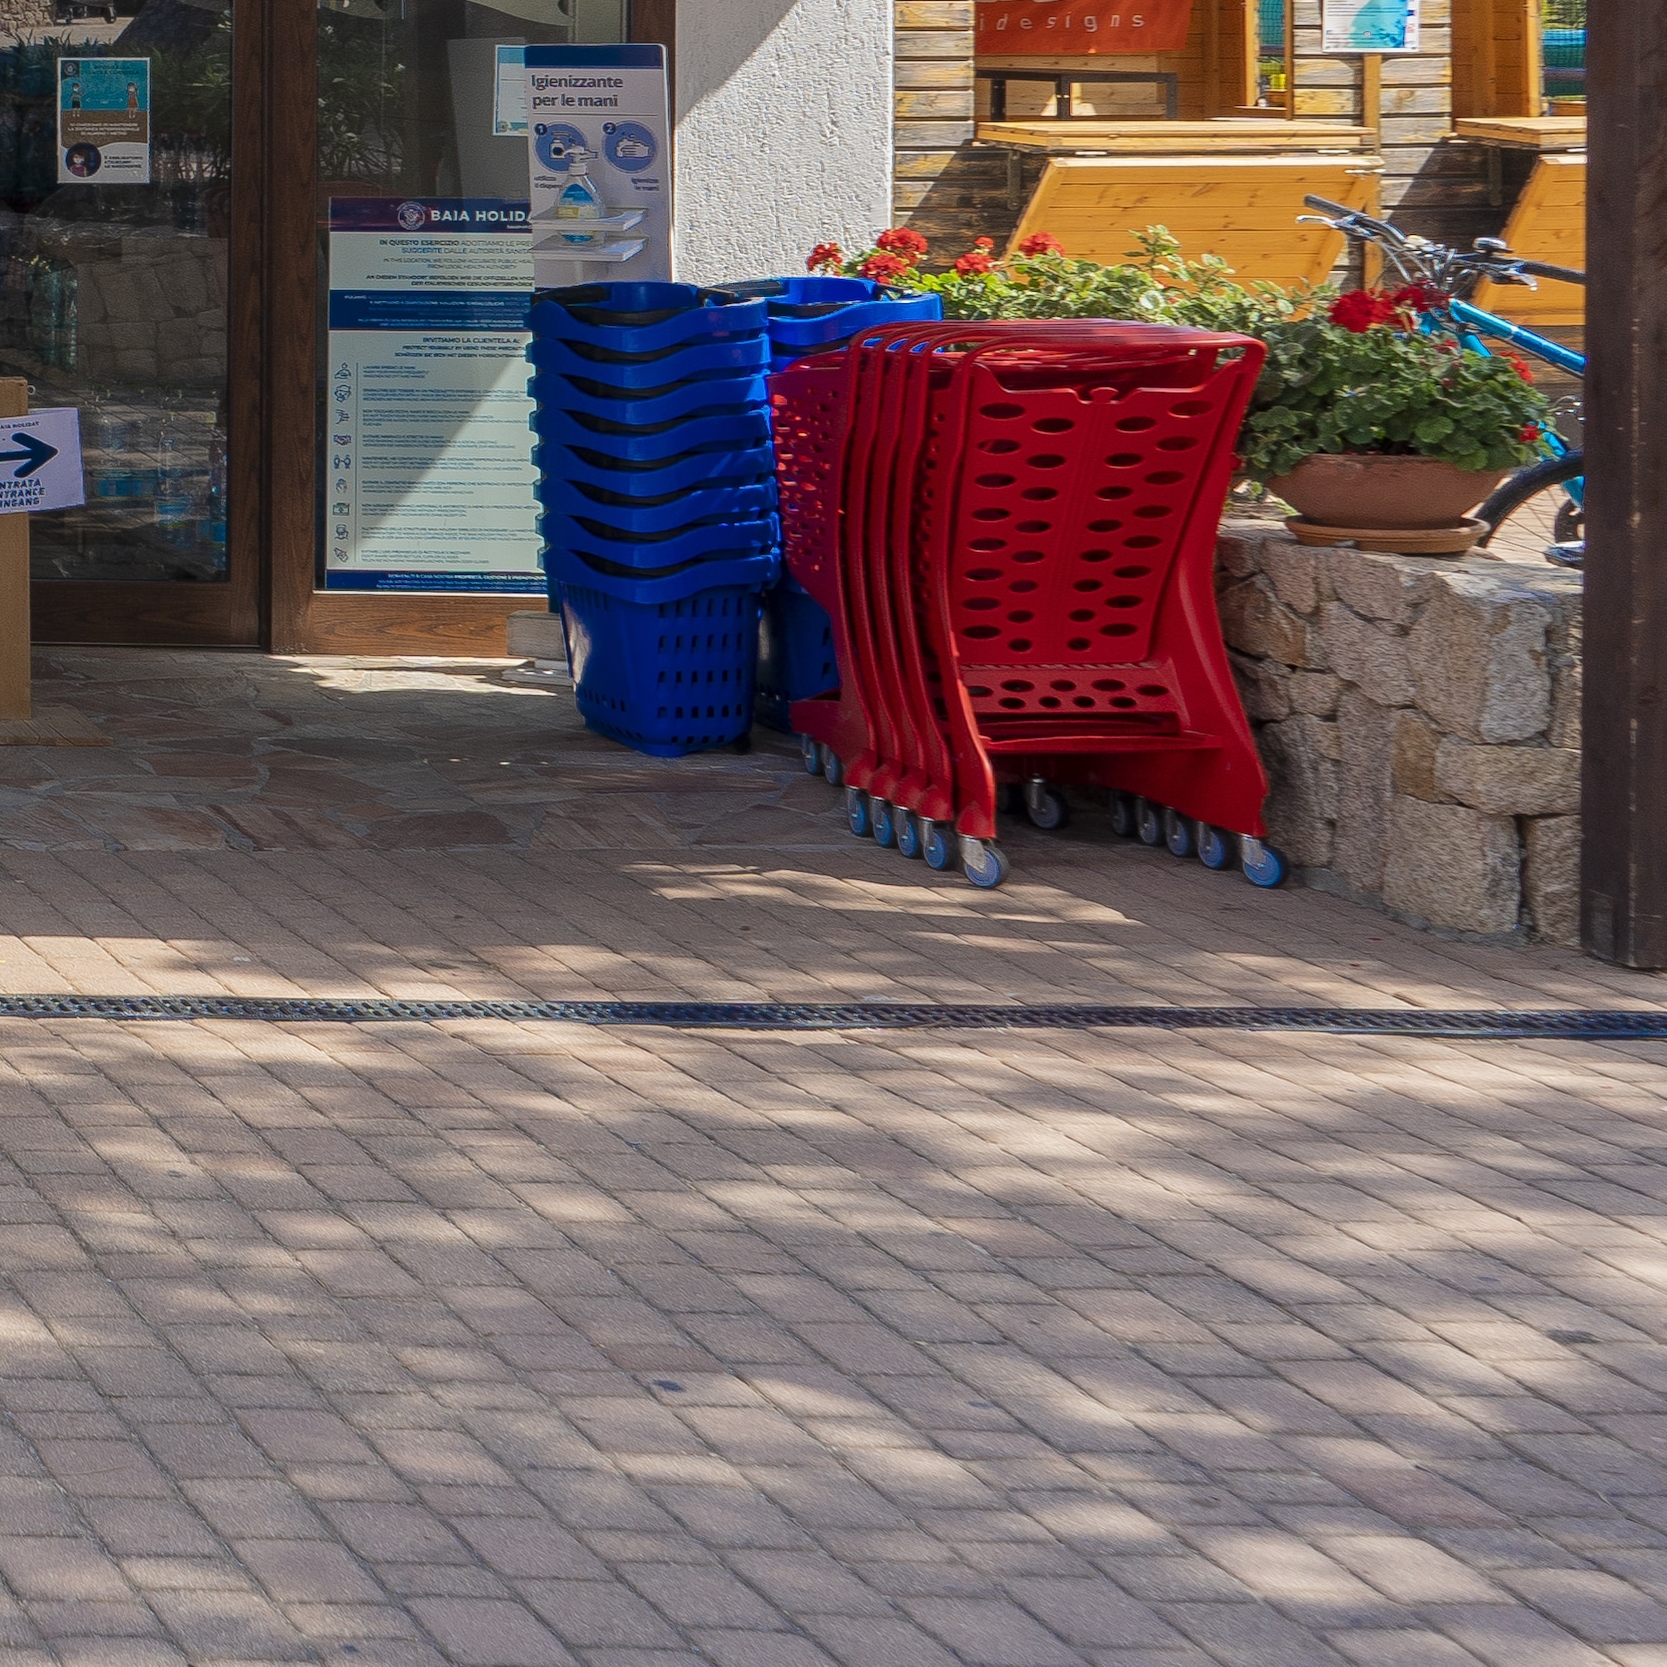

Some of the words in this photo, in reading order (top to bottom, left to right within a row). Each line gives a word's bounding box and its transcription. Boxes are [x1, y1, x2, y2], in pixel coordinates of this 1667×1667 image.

[531, 74, 624, 91] Igienizzante
[532, 95, 558, 109] per
[561, 94, 576, 107] le
[577, 94, 618, 107] mani
[430, 209, 471, 222] BAIA
